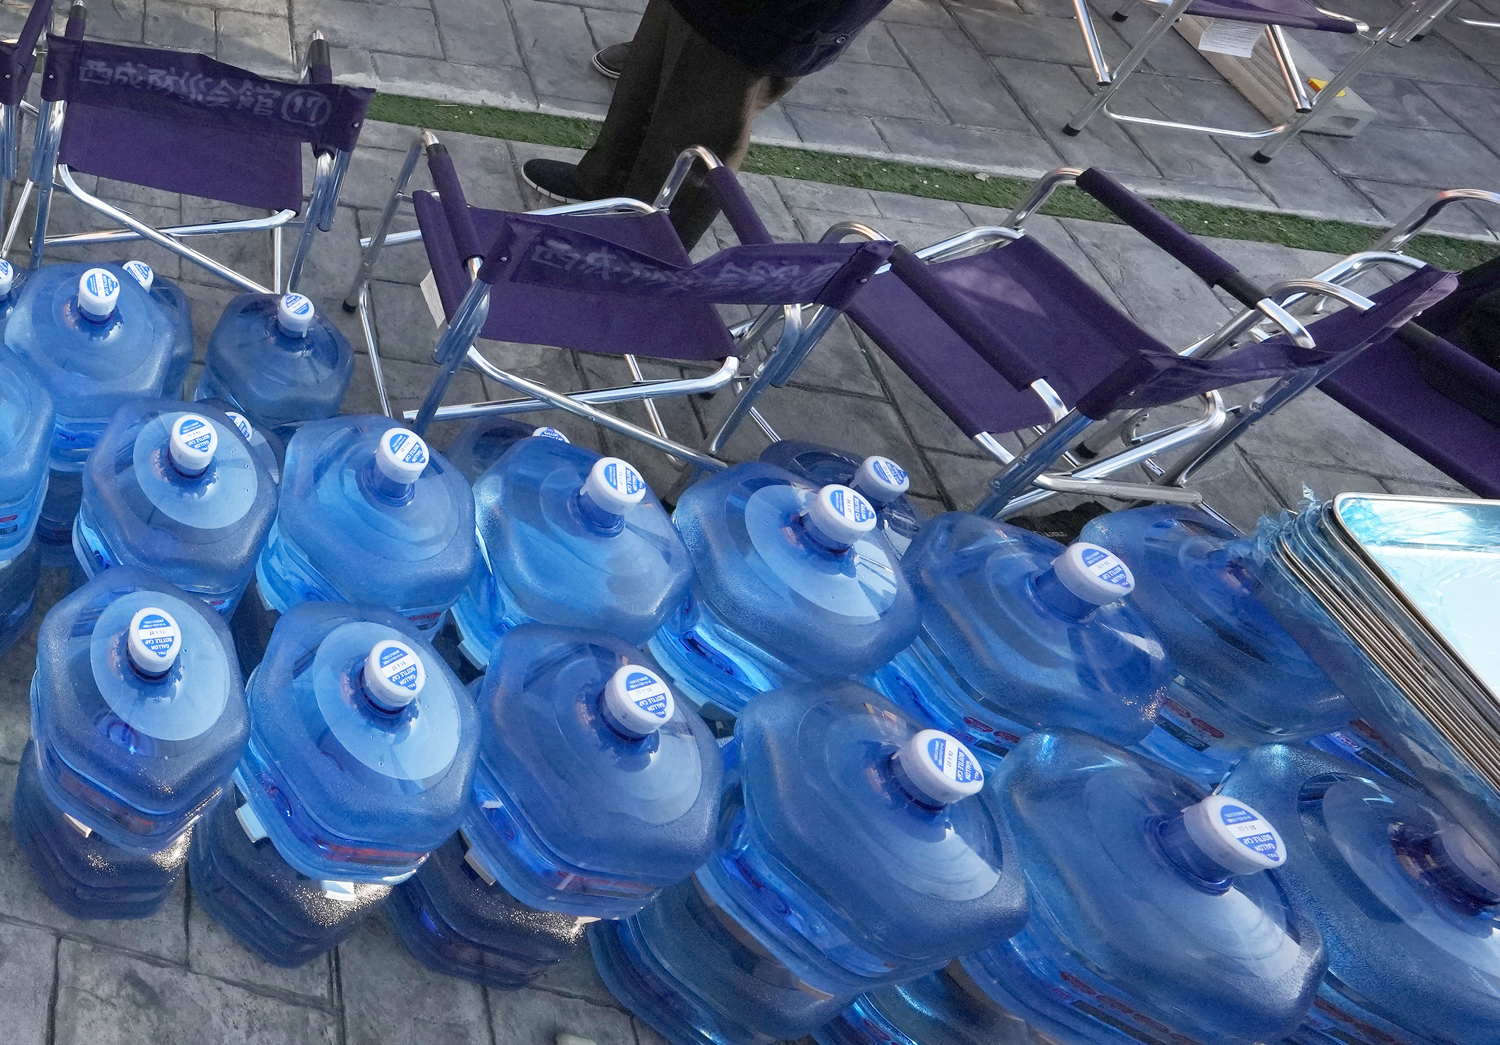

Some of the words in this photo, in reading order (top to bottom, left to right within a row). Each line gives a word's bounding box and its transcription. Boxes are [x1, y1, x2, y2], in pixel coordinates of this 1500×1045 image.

[399, 674, 416, 686] GALLON
[646, 703, 665, 712] GALLON
[1253, 843, 1276, 852] GALLON
